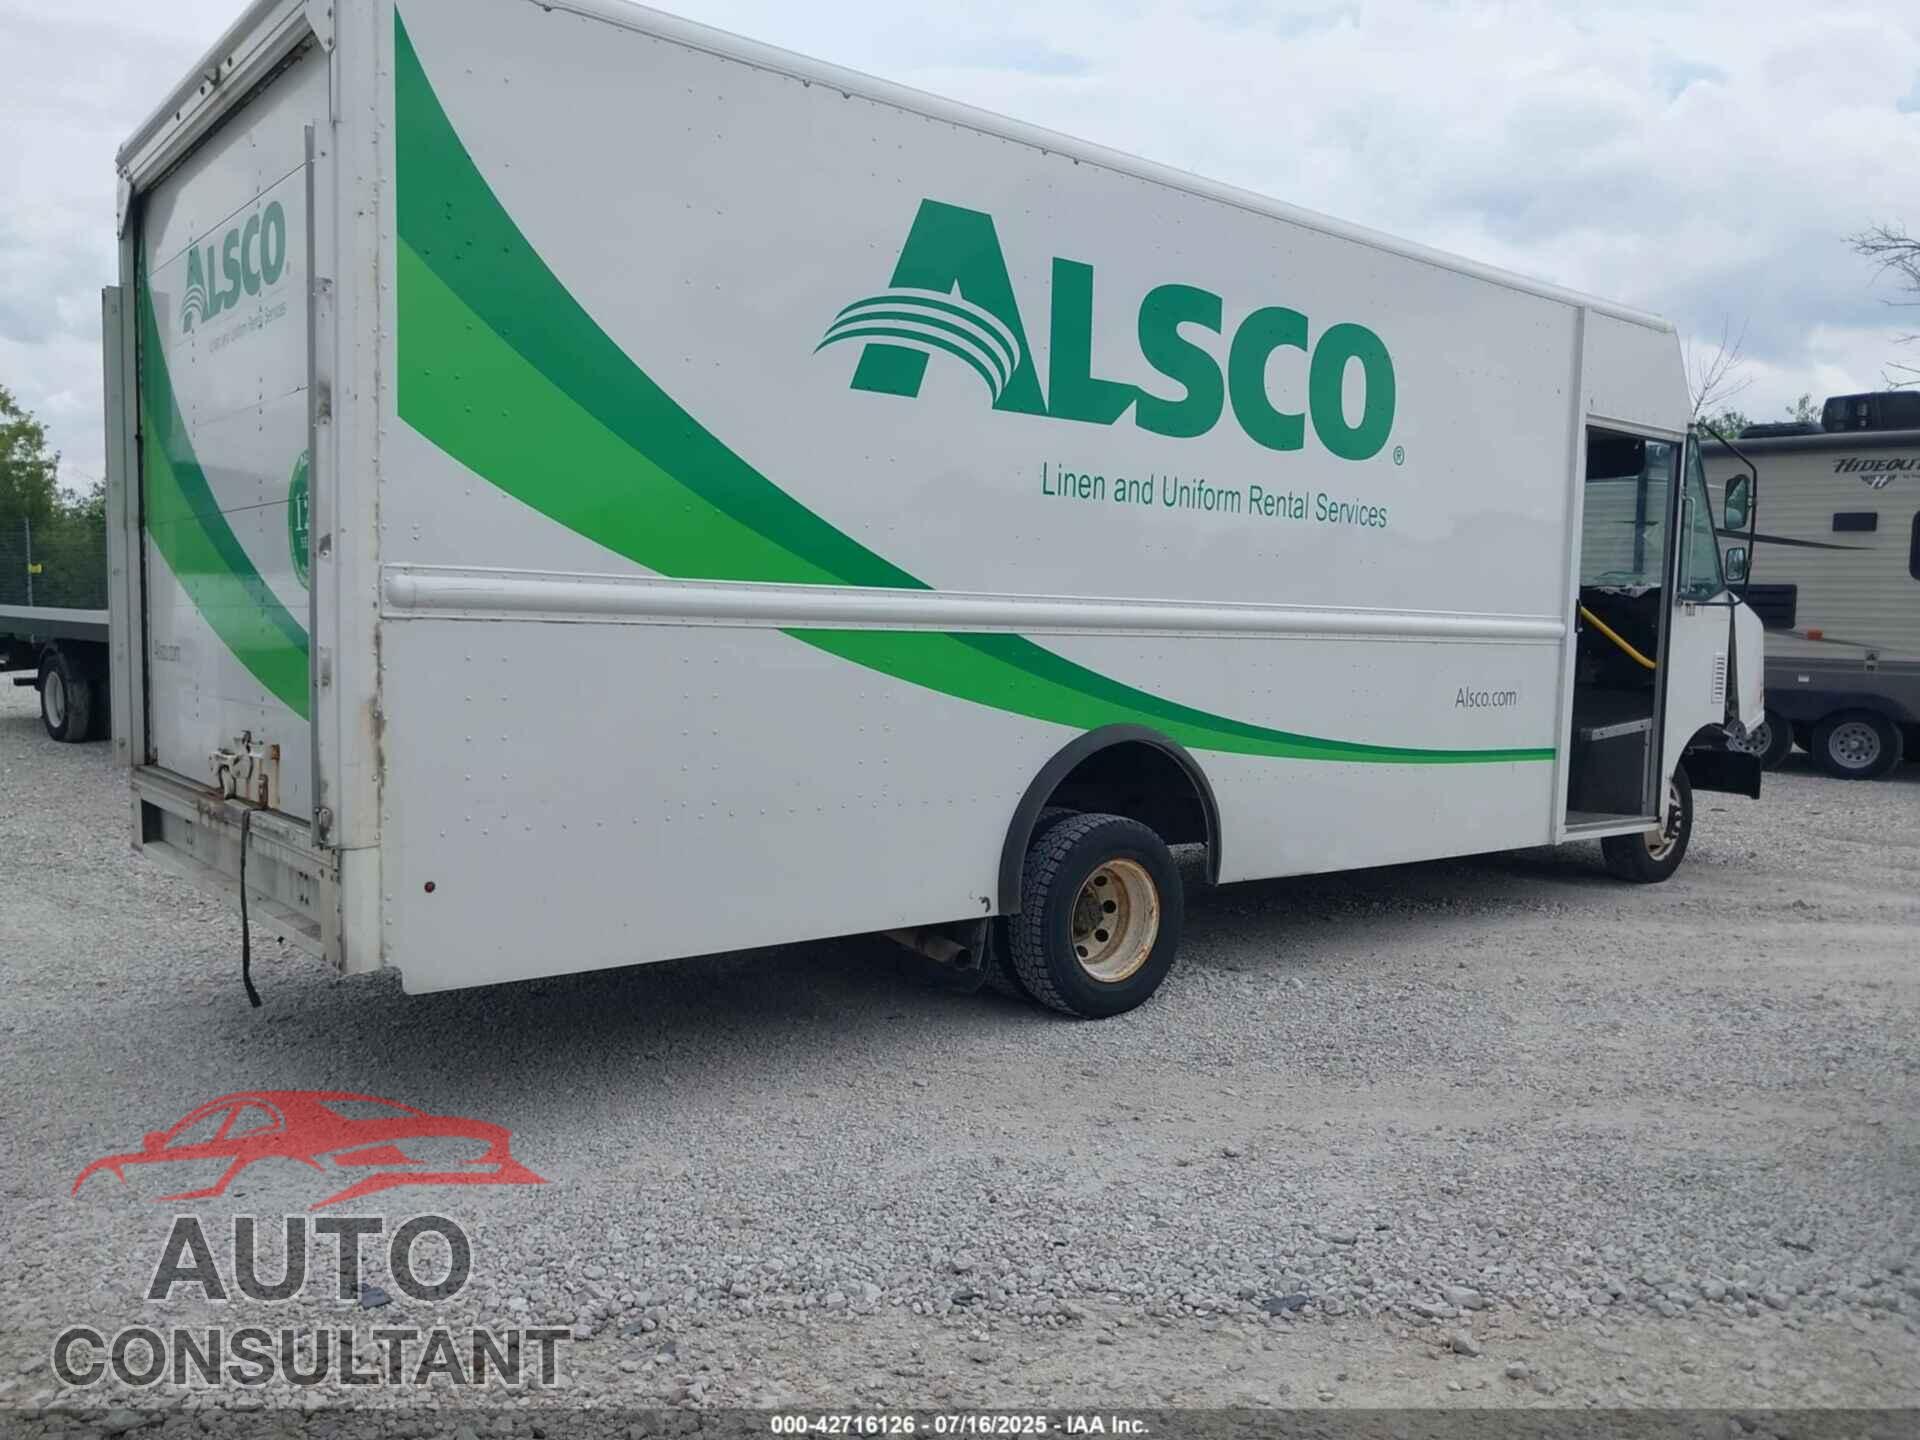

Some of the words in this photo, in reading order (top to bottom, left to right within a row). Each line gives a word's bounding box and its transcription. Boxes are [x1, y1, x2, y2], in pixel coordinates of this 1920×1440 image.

[182, 201, 286, 333] ALSCO
[813, 198, 1396, 461] ALSCO
[1042, 461, 1105, 500] Linen
[1113, 473, 1154, 506] and
[1162, 475, 1241, 514] Uniform
[1249, 485, 1309, 520] Rental
[1315, 493, 1387, 528] Services
[1455, 686, 1517, 708] Alsco.com
